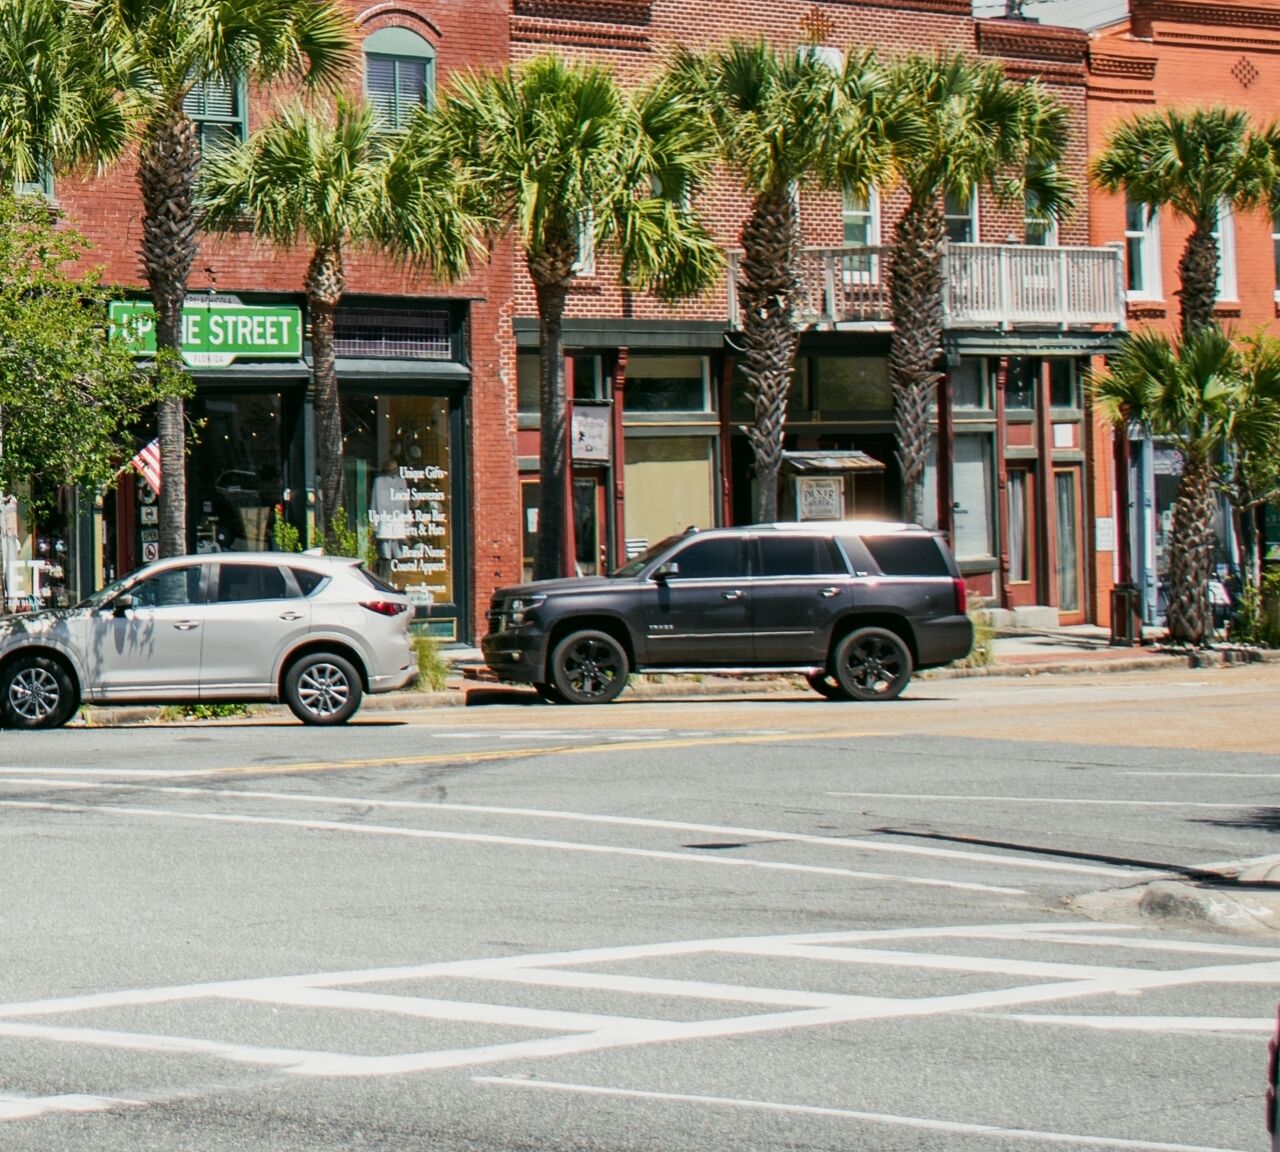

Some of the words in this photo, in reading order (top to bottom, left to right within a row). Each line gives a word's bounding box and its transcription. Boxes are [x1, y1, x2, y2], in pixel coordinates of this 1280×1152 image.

[207, 315, 291, 345] STREET
[425, 465, 445, 479] Gifts
[368, 509, 380, 526] Up
